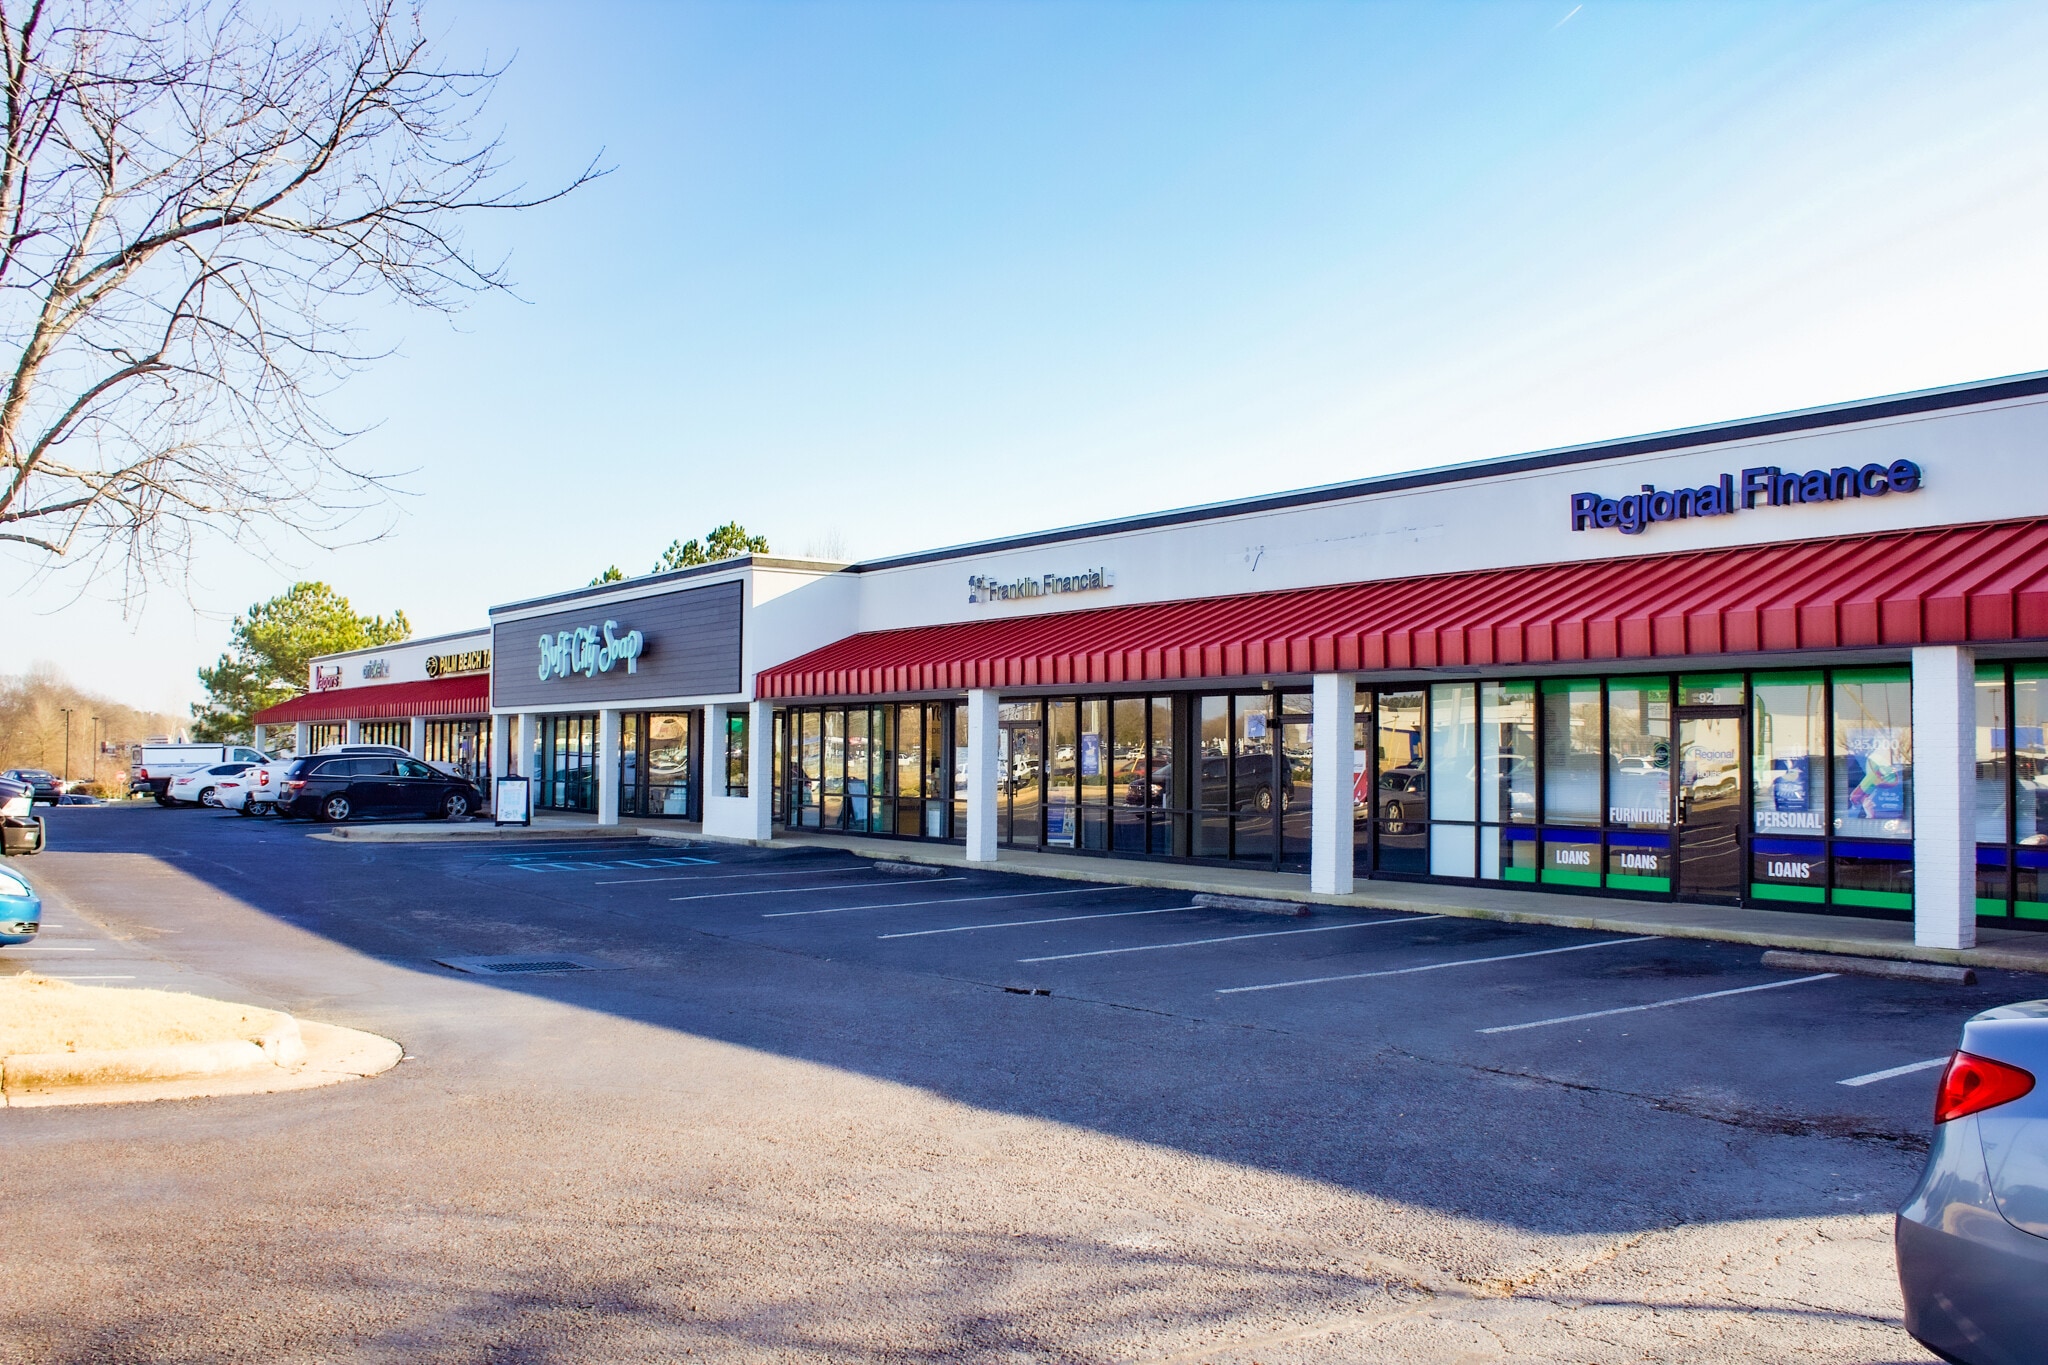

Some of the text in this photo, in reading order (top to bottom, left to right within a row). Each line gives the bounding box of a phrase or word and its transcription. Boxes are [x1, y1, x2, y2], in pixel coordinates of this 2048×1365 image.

[1571, 459, 1921, 535] Regional Finance
[990, 577, 1042, 601] Franklin
[1043, 567, 1105, 596] Financial
[539, 620, 643, 680] Buff City Soap
[440, 654, 458, 674] PALM
[459, 651, 482, 671] BEACH
[316, 666, 339, 691] Vapors
[1699, 692, 1720, 704] 920
[1694, 748, 1735, 761] Regional
[1609, 807, 1670, 824] FURNITURE
[1756, 811, 1823, 829] PERSONAL
[1556, 850, 1591, 866] LOANS
[1621, 853, 1658, 870] LOANS
[1768, 861, 1810, 879] LOANS
